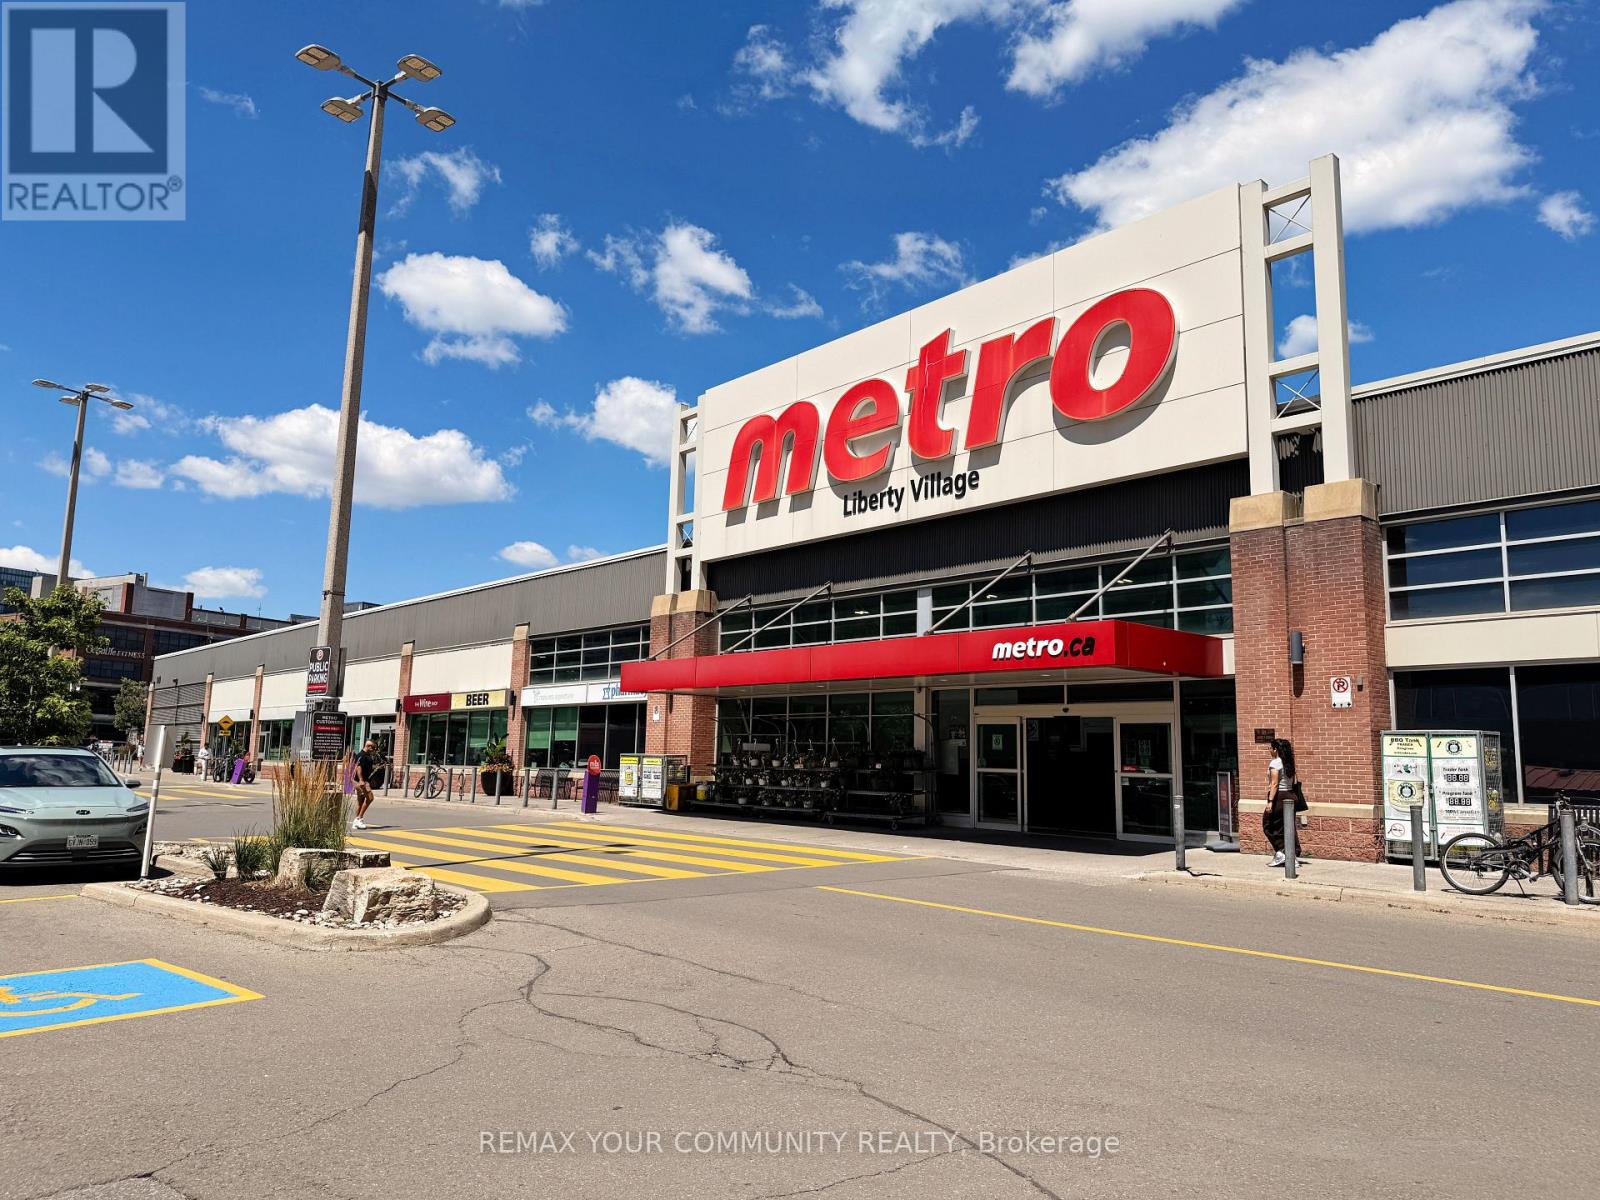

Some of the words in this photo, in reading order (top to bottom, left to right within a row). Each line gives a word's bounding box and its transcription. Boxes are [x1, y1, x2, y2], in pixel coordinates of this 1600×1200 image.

[722, 287, 1179, 512] metro
[843, 485, 905, 518] Liberty
[910, 470, 980, 503] Village
[992, 636, 1095, 660] metro.ca
[309, 662, 329, 672] PUBLIC
[308, 673, 328, 683] PARKING
[466, 693, 489, 706] BEER
